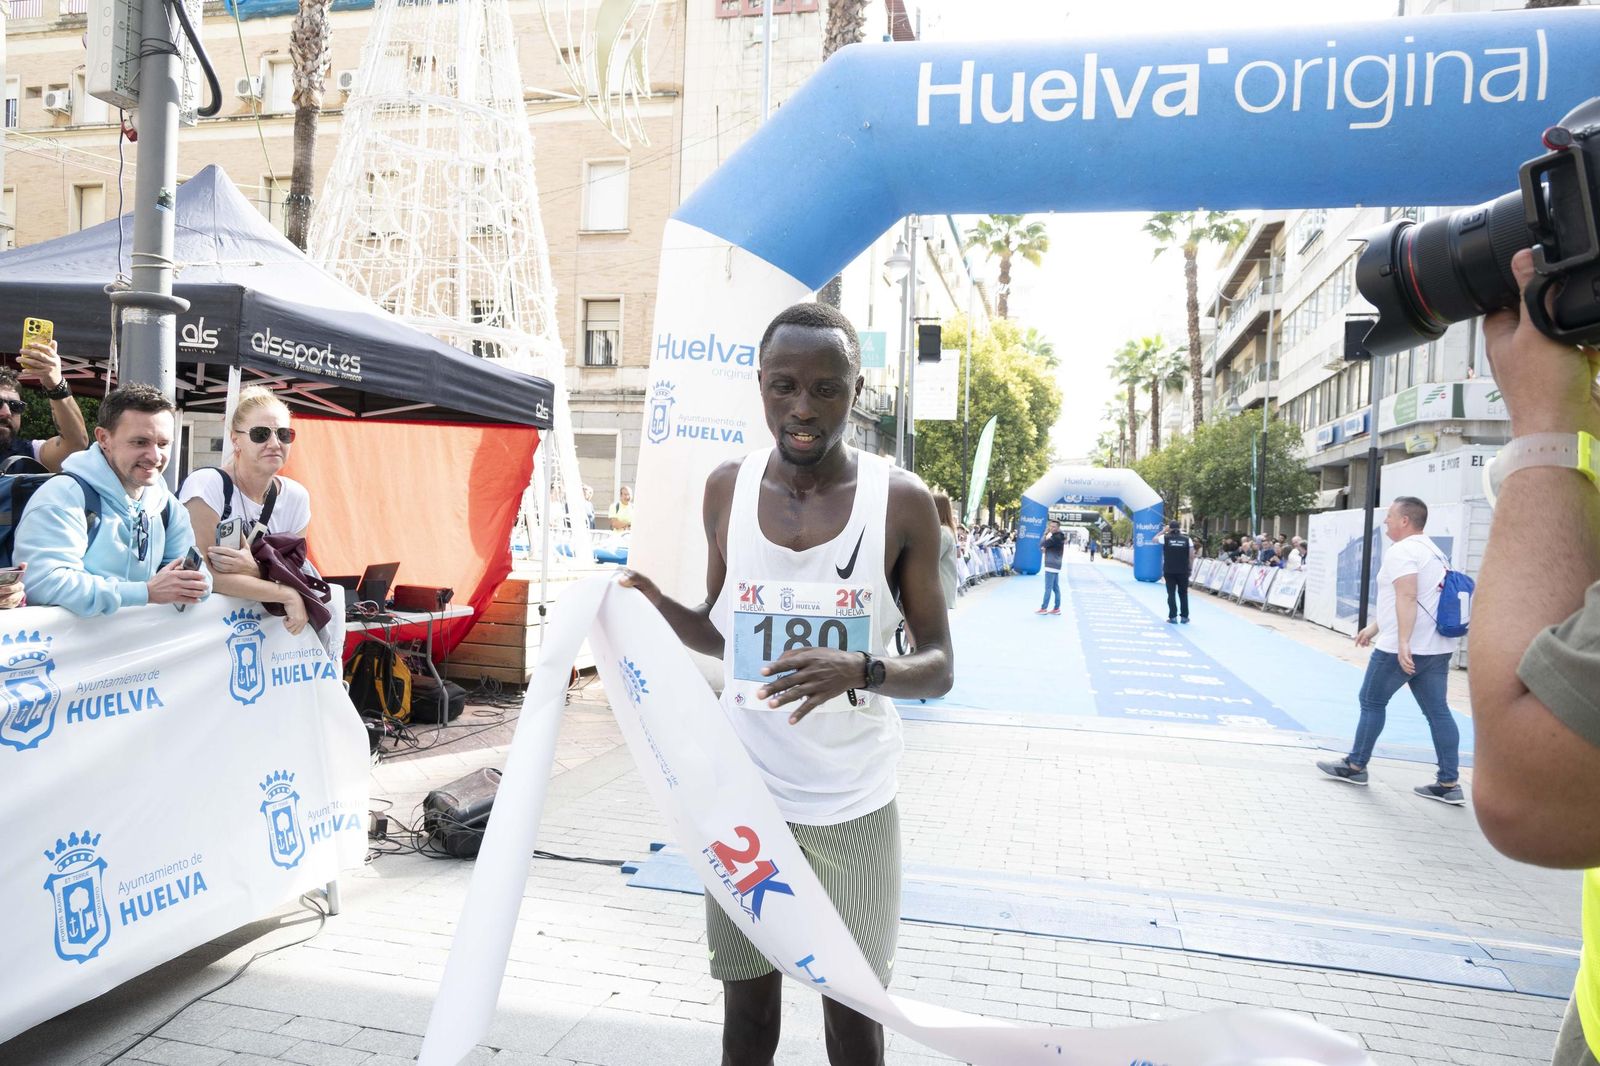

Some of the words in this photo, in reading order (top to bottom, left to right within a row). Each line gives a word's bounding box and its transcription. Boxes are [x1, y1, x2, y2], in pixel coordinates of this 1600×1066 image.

[917, 53, 1200, 126] Huelva
[1234, 29, 1548, 130] original
[179, 317, 220, 348] als
[251, 328, 361, 374] alssport.es
[656, 333, 756, 367] Huelva
[676, 424, 744, 444] HUELVA
[836, 588, 865, 609] 21K
[836, 608, 864, 616] HUELVA
[754, 616, 848, 662] 180
[76, 671, 147, 694] Ayuntamiento
[148, 665, 160, 680] de
[66, 687, 165, 724] HUELVA
[118, 860, 189, 897] Ayuntamiento
[191, 853, 203, 865] de
[702, 848, 756, 924] HUELVA
[709, 825, 796, 921] 21K
[119, 871, 208, 926] HUELVA
